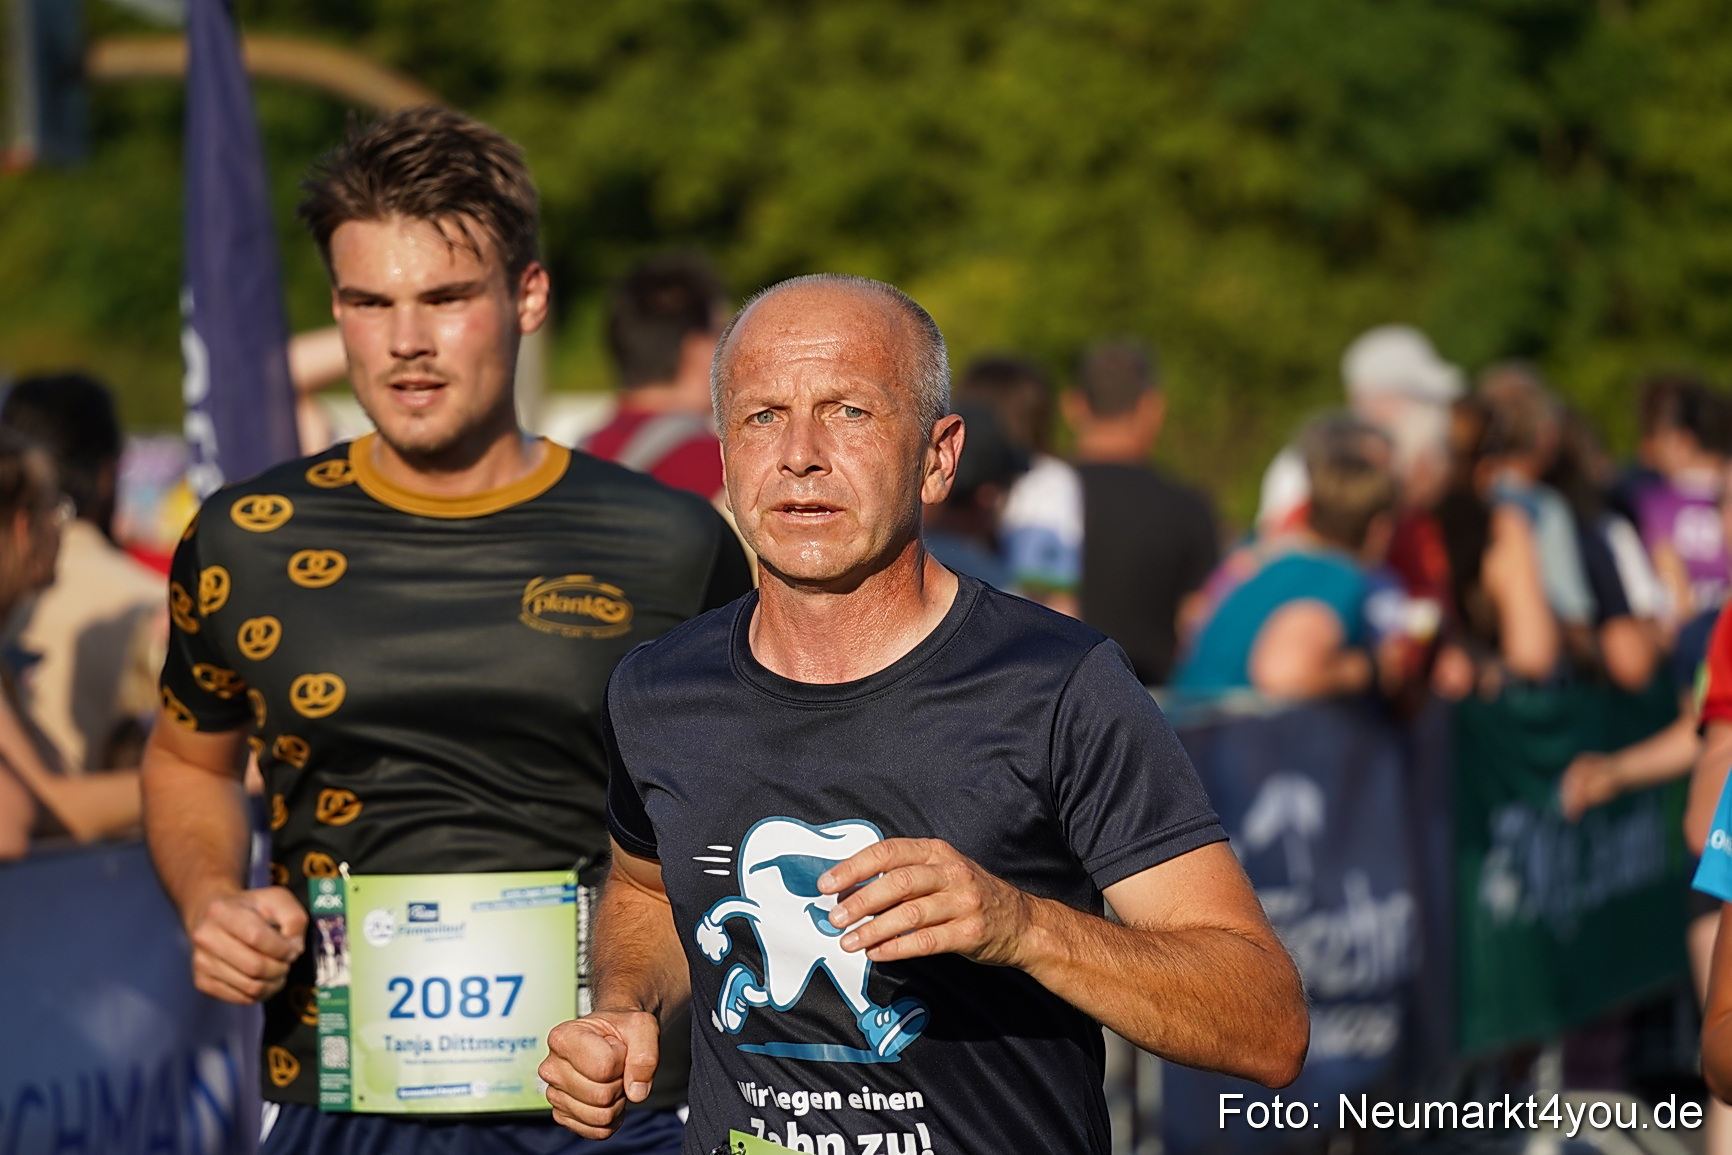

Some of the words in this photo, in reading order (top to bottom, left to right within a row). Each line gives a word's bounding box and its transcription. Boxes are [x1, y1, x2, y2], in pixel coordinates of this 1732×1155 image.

[314, 894, 343, 909] AOK
[388, 975, 524, 1018] 2087
[384, 1034, 432, 1056] Tanja
[439, 1034, 538, 1053] Dittmeyer
[768, 1086, 842, 1116] legen
[848, 1086, 924, 1111] einen
[857, 1123, 935, 1155] zu!
